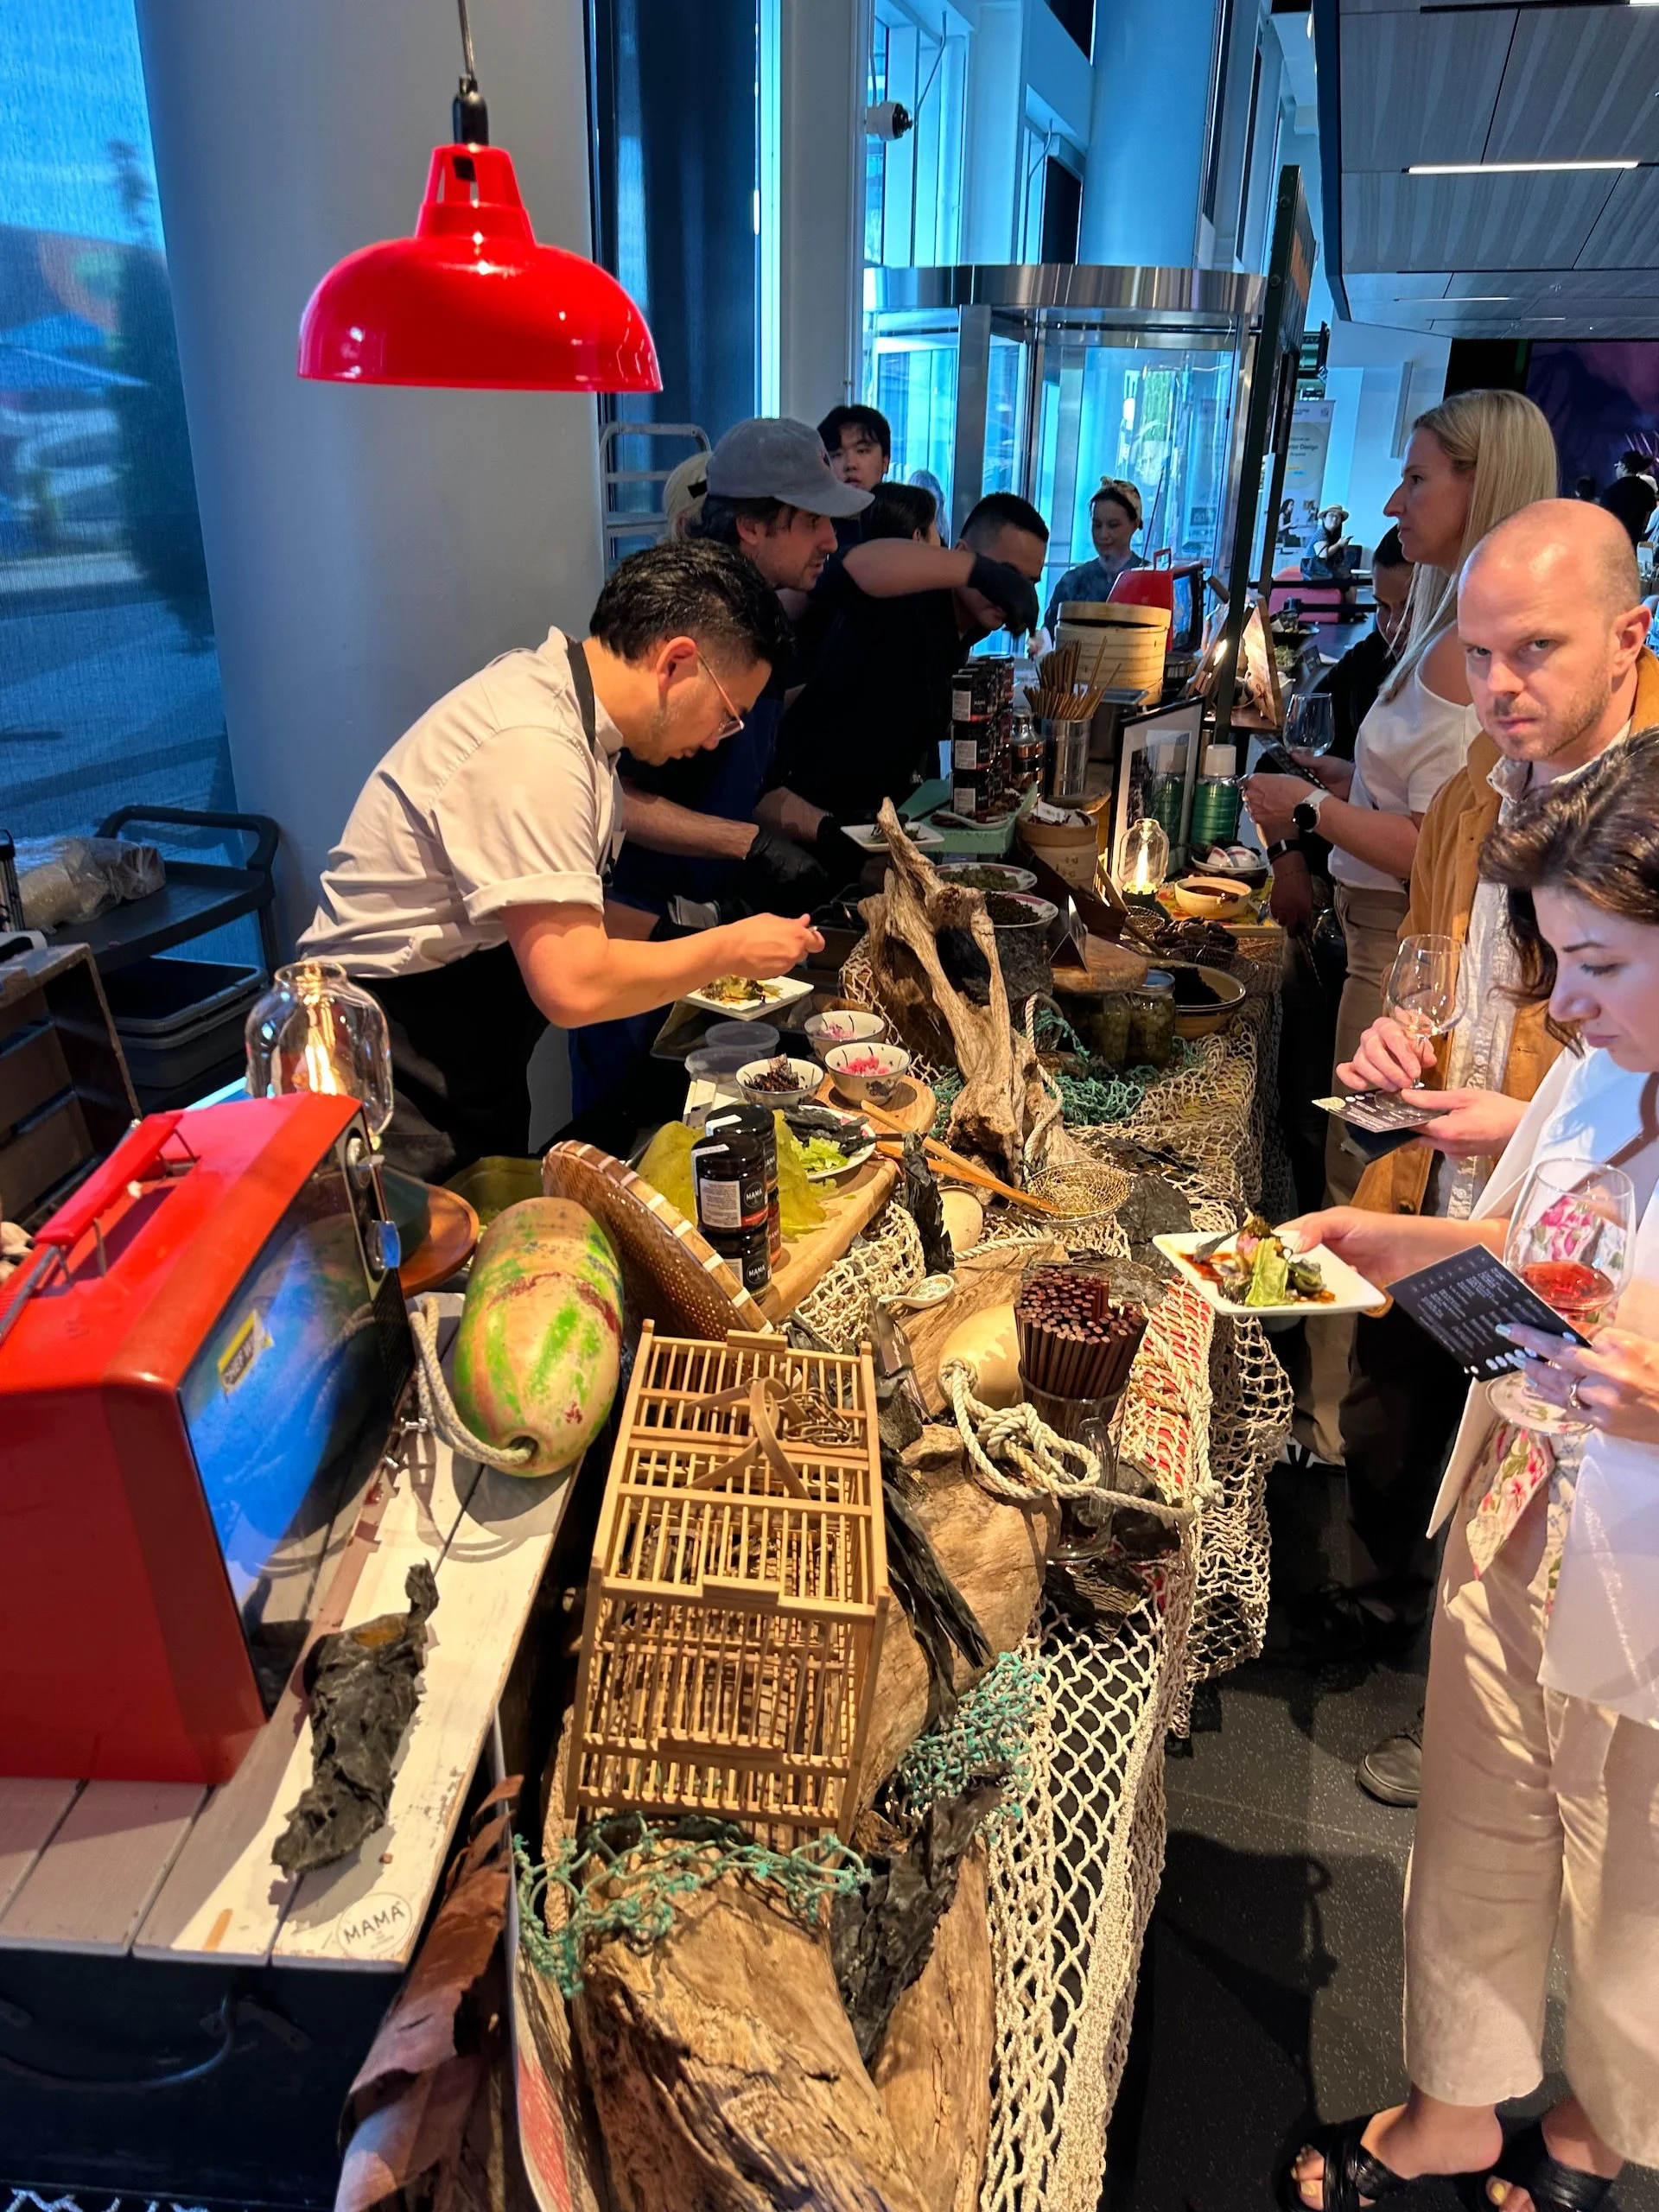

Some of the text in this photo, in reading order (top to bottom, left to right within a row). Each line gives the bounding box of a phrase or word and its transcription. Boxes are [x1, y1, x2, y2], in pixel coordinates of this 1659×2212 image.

[746, 1187, 763, 1201] MAMA
[748, 1264, 766, 1277] MAMA
[343, 1900, 405, 1944] MAMA
